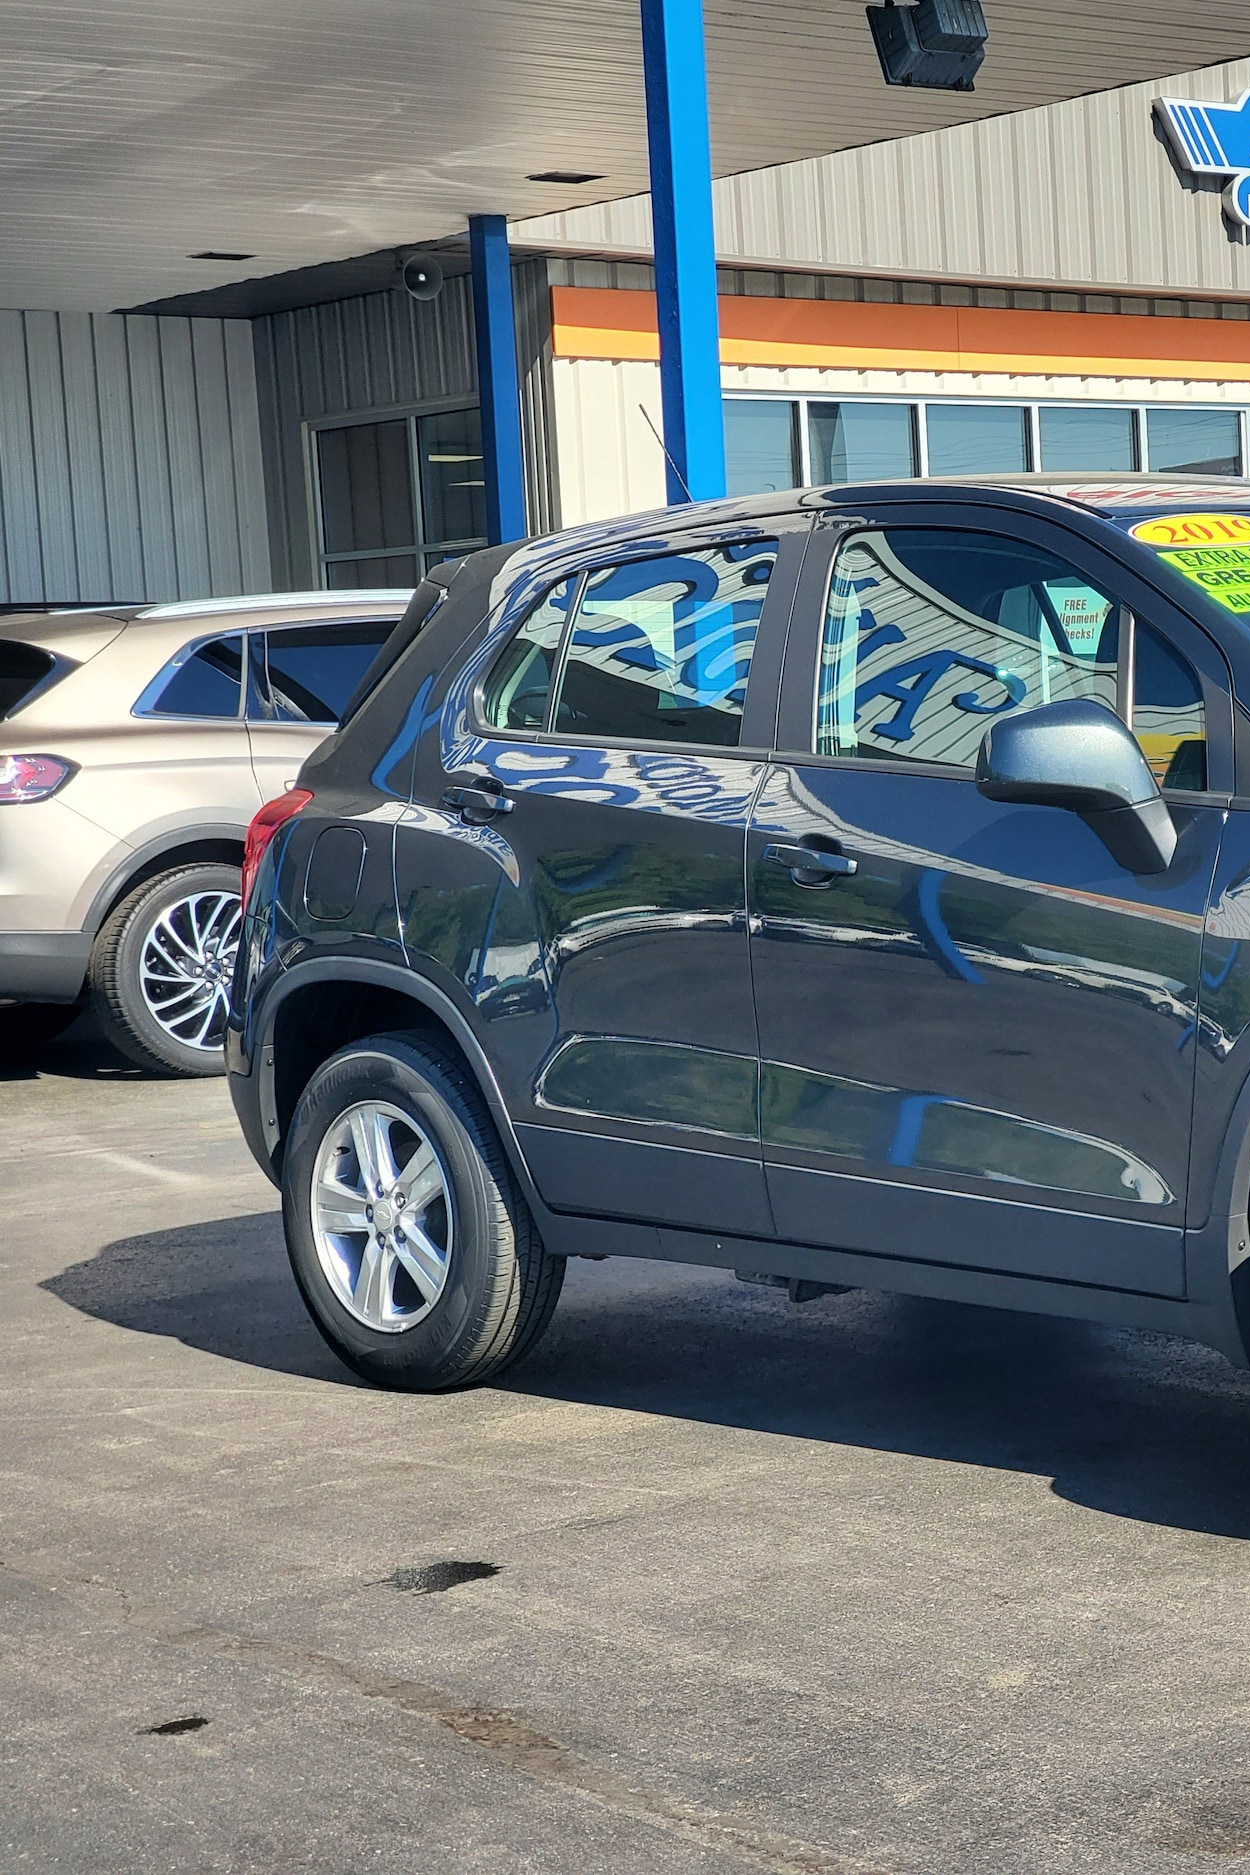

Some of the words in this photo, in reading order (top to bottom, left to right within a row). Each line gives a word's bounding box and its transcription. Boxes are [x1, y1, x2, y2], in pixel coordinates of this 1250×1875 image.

[1064, 599, 1088, 611] FREE
[1060, 612, 1099, 627] lignment
[1065, 628, 1095, 640] hecks!
